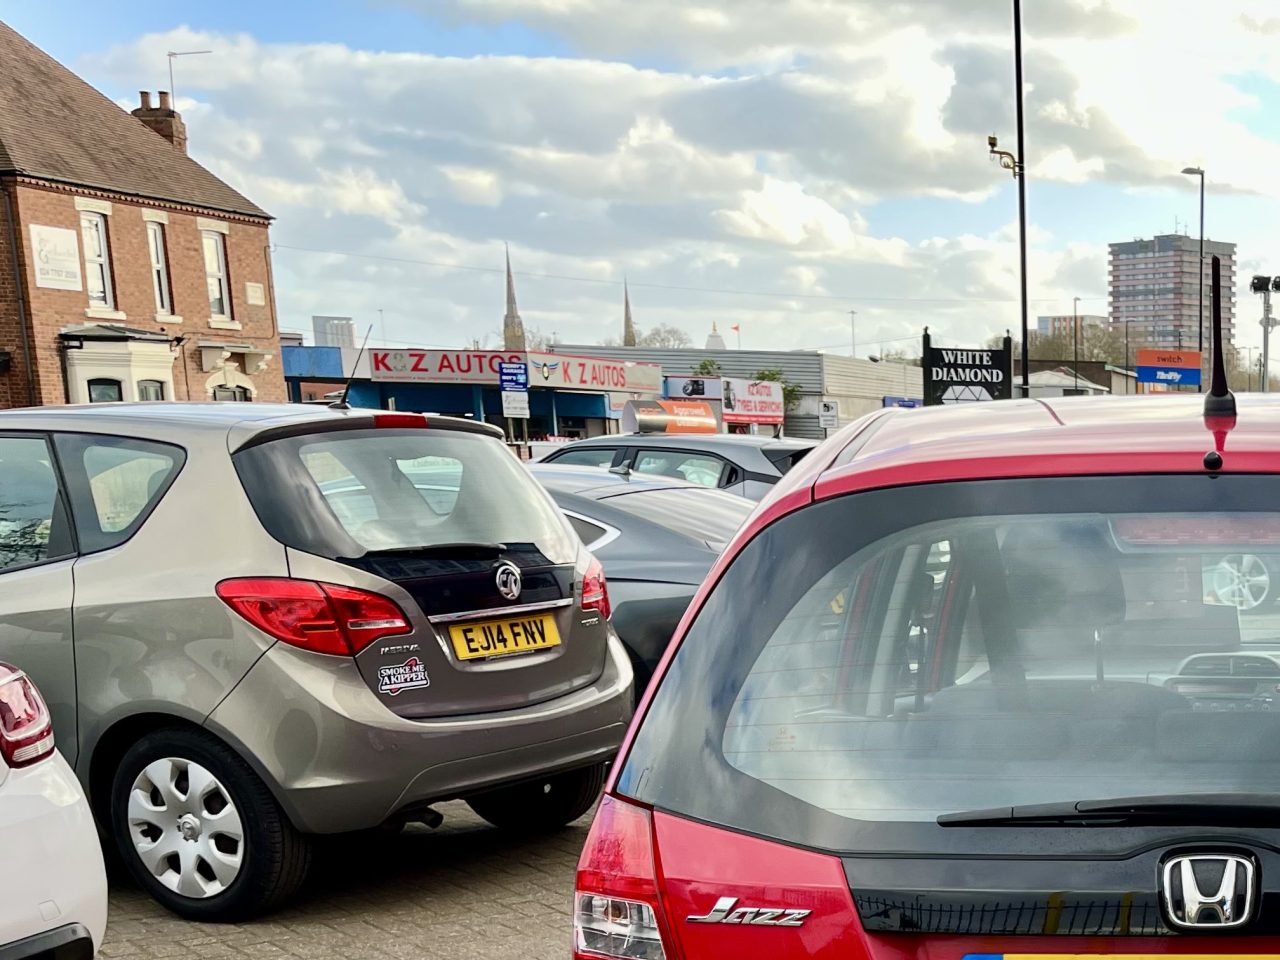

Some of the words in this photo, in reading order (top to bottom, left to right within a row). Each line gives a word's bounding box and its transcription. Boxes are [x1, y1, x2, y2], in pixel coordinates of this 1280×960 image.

[373, 352, 392, 371] K
[408, 353, 428, 372] Z
[941, 350, 993, 365] WHITE
[1156, 355, 1183, 363] switch
[562, 361, 572, 383] K
[578, 362, 588, 385] Z
[591, 364, 626, 388] AUTOS
[931, 367, 1004, 383] DIAMOND
[463, 623, 509, 654] EJ14
[512, 618, 548, 648] FNV
[380, 665, 411, 677] SMOKE
[411, 664, 425, 673] ME
[382, 676, 390, 685] A
[390, 671, 426, 684] KIPPER
[686, 896, 813, 927] Jazz
